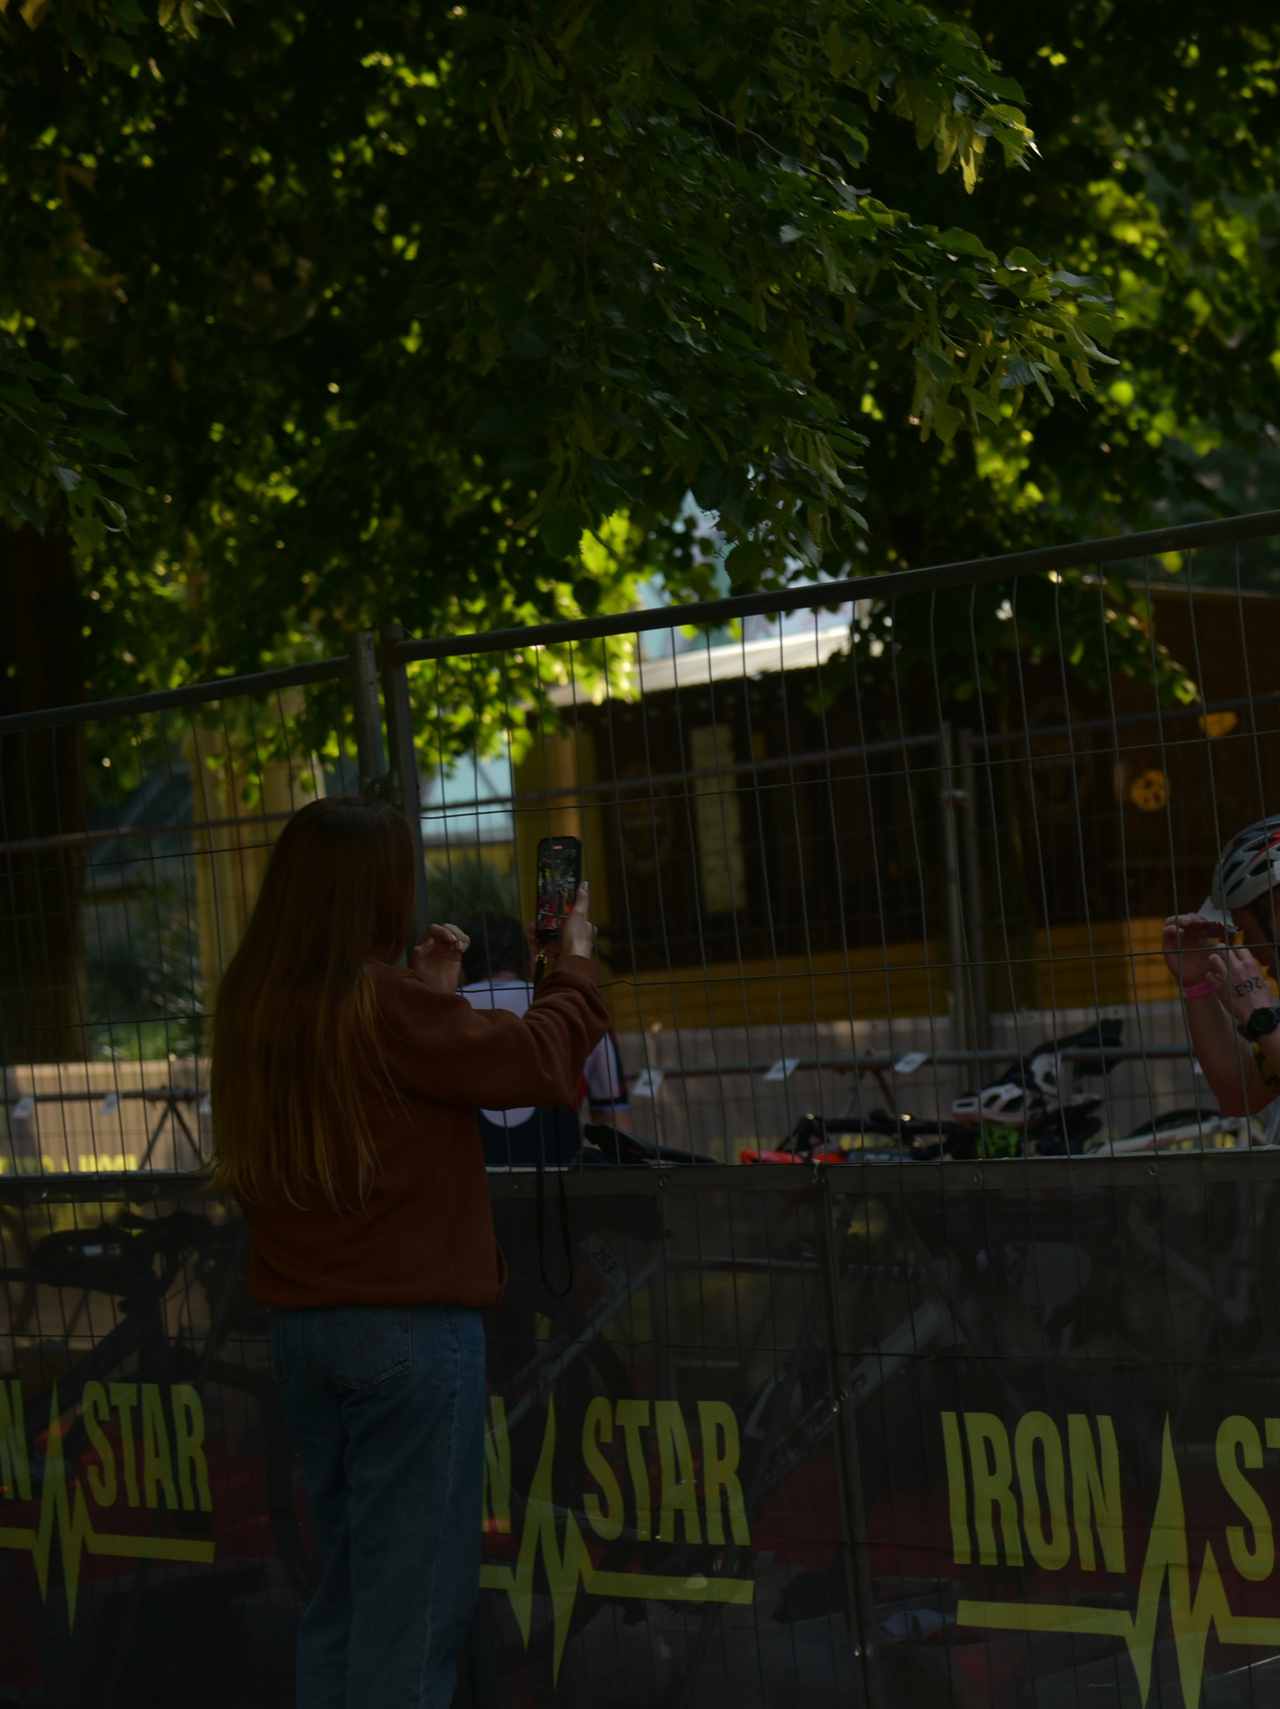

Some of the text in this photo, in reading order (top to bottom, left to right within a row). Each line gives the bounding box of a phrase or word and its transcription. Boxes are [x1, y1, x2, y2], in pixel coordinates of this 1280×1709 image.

[1235, 977, 1262, 997] 263
[591, 1245, 617, 1274] 263
[82, 1380, 213, 1512] STAR
[581, 1396, 751, 1546] STAR
[940, 1410, 1126, 1574] IRON
